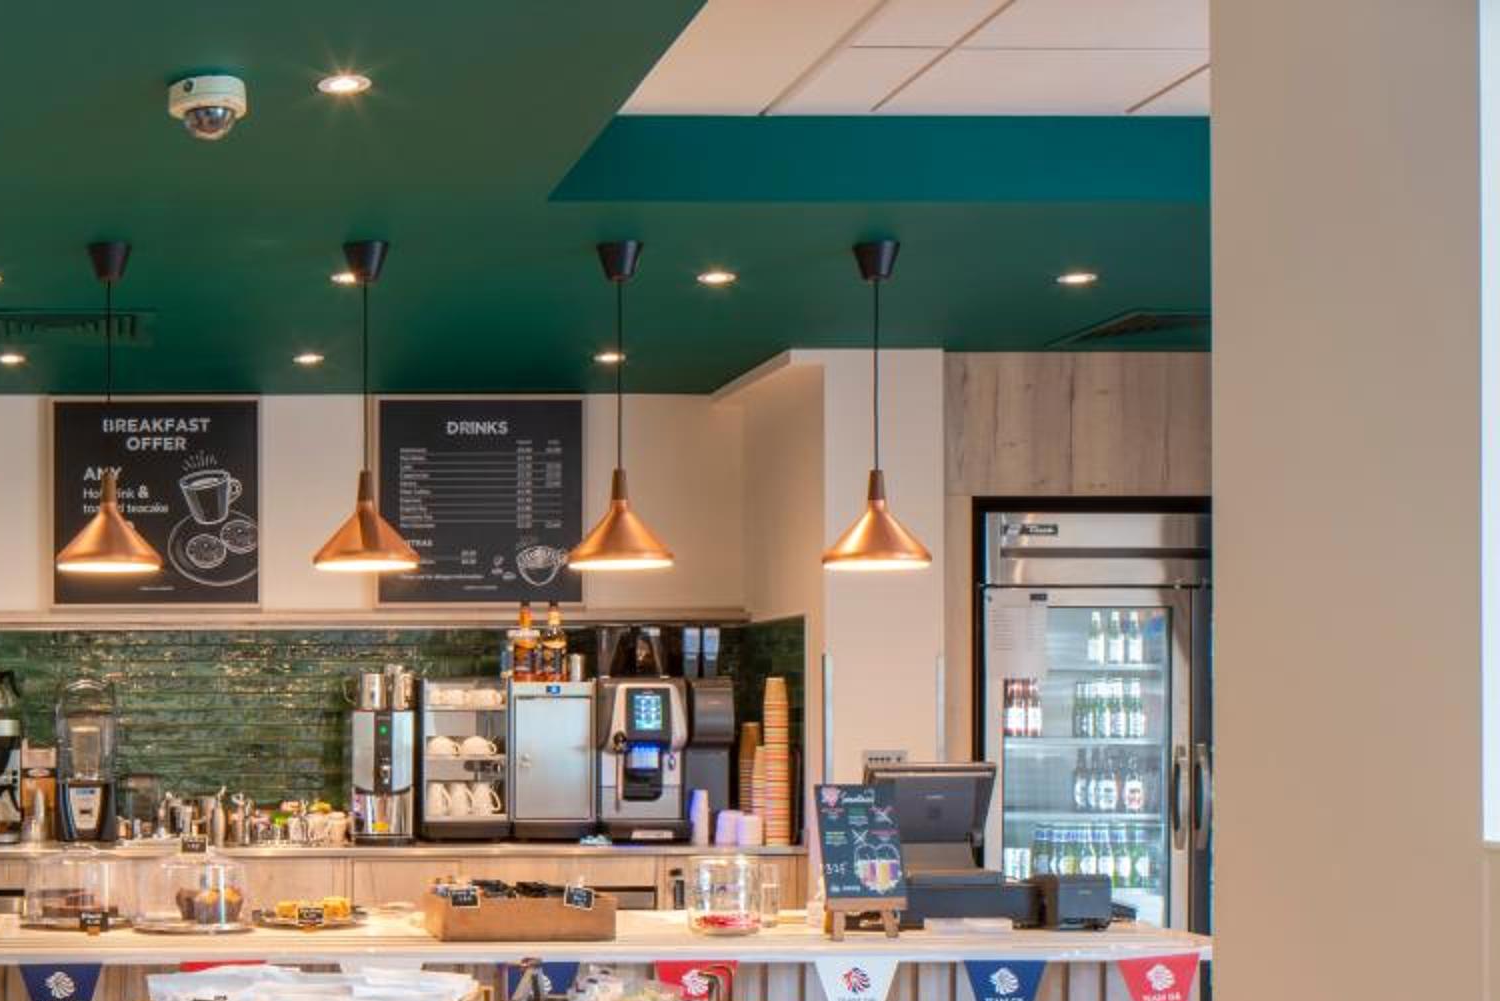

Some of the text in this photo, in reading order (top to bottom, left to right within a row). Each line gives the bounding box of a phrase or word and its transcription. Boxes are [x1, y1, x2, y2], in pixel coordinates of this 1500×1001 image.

[102, 418, 211, 433] BREAKFAST
[446, 421, 508, 435] DRINKS
[126, 436, 187, 451] OFFER
[137, 485, 149, 498] &
[1168, 992, 1181, 1001] GB
